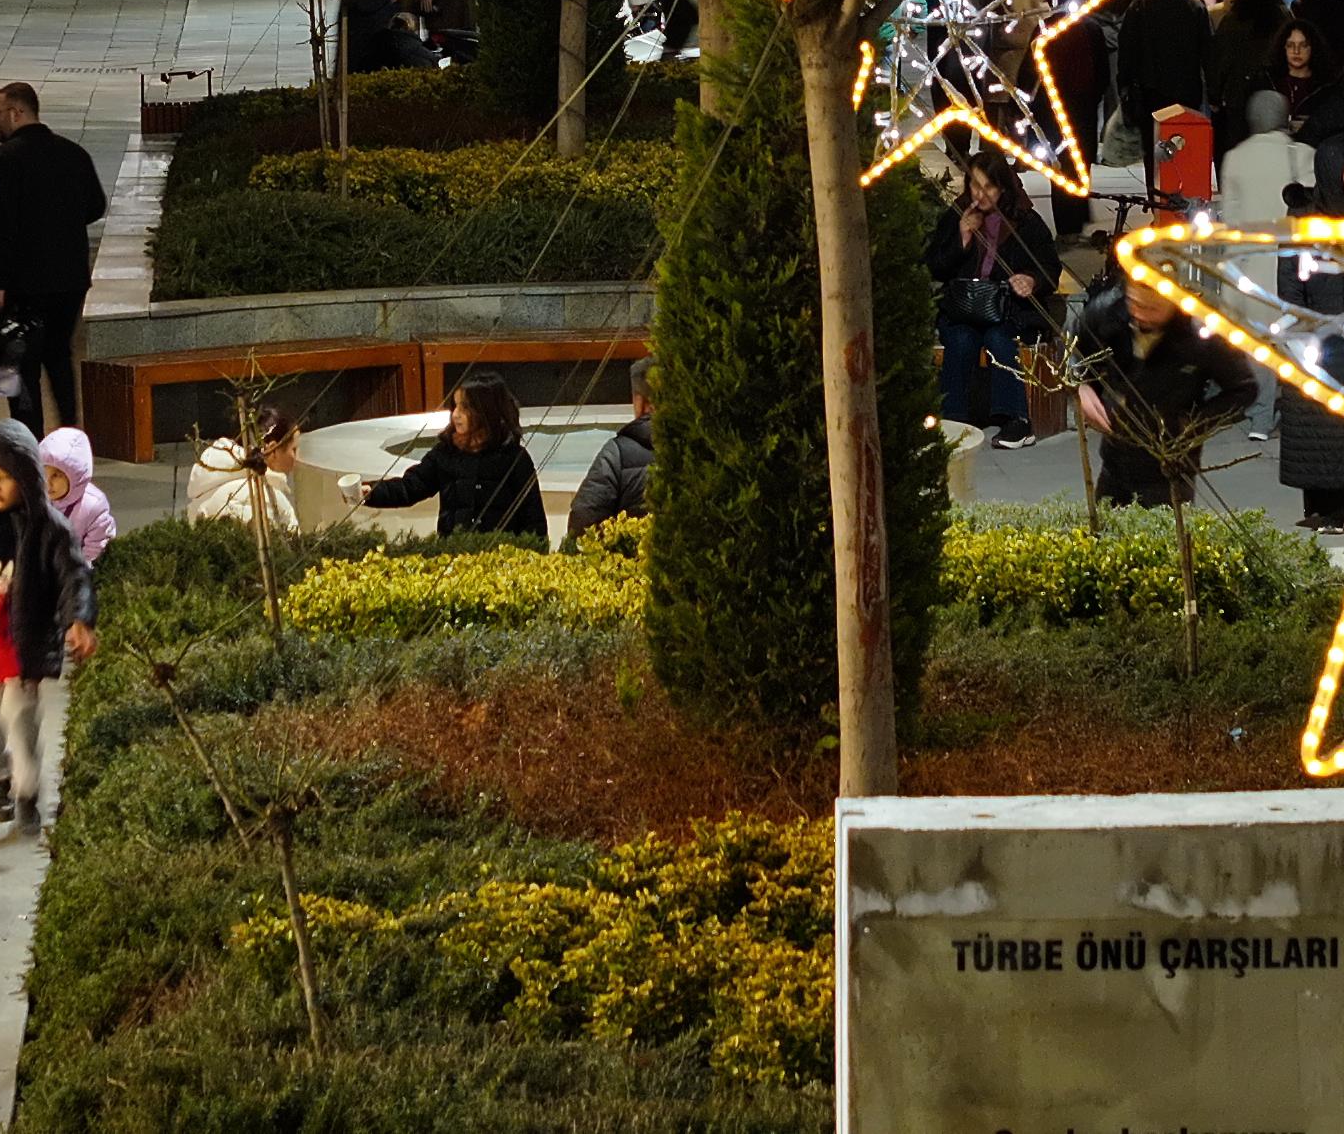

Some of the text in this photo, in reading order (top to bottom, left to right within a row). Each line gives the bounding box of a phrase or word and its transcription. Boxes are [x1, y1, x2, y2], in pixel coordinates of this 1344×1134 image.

[951, 930, 1340, 979] TÜRBE ÖNÜ ÇARŞILARI
